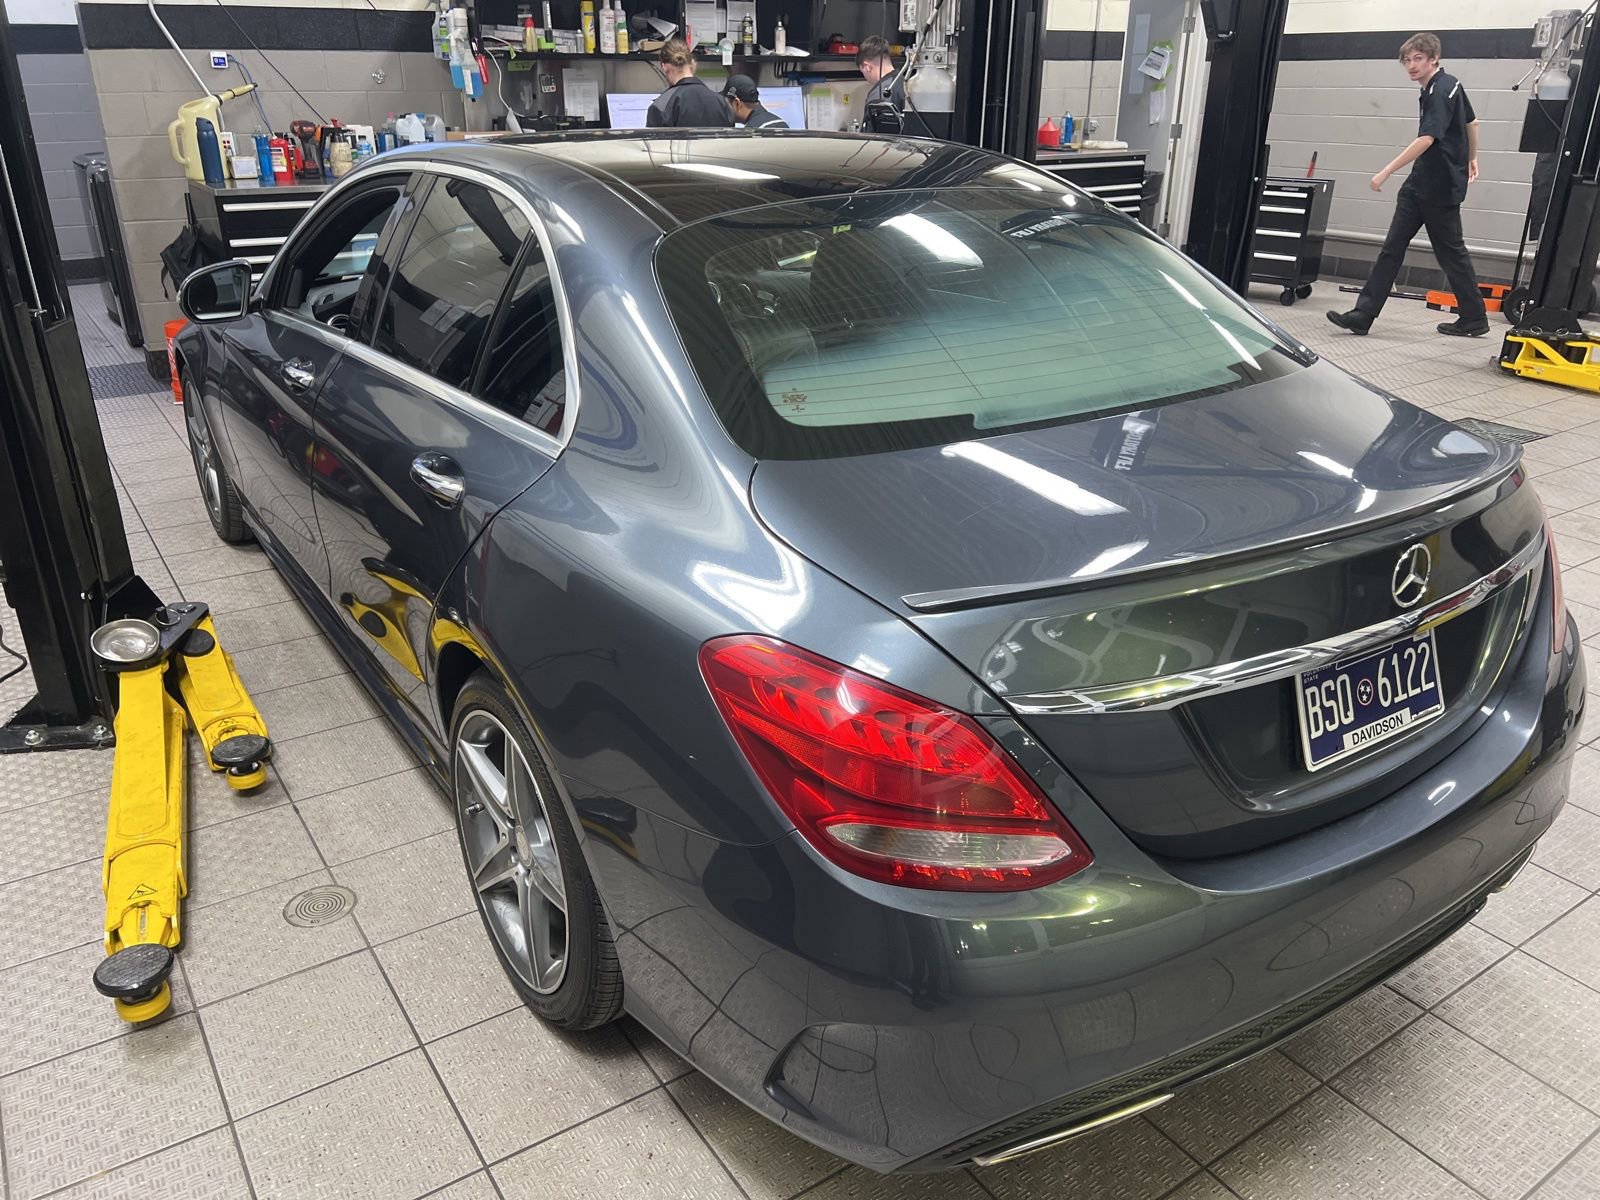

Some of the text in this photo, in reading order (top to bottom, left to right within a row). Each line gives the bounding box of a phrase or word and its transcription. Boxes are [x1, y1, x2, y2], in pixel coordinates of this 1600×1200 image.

[1305, 642, 1435, 739] BSQ 6122
[1352, 714, 1404, 745] DAVIDSON
